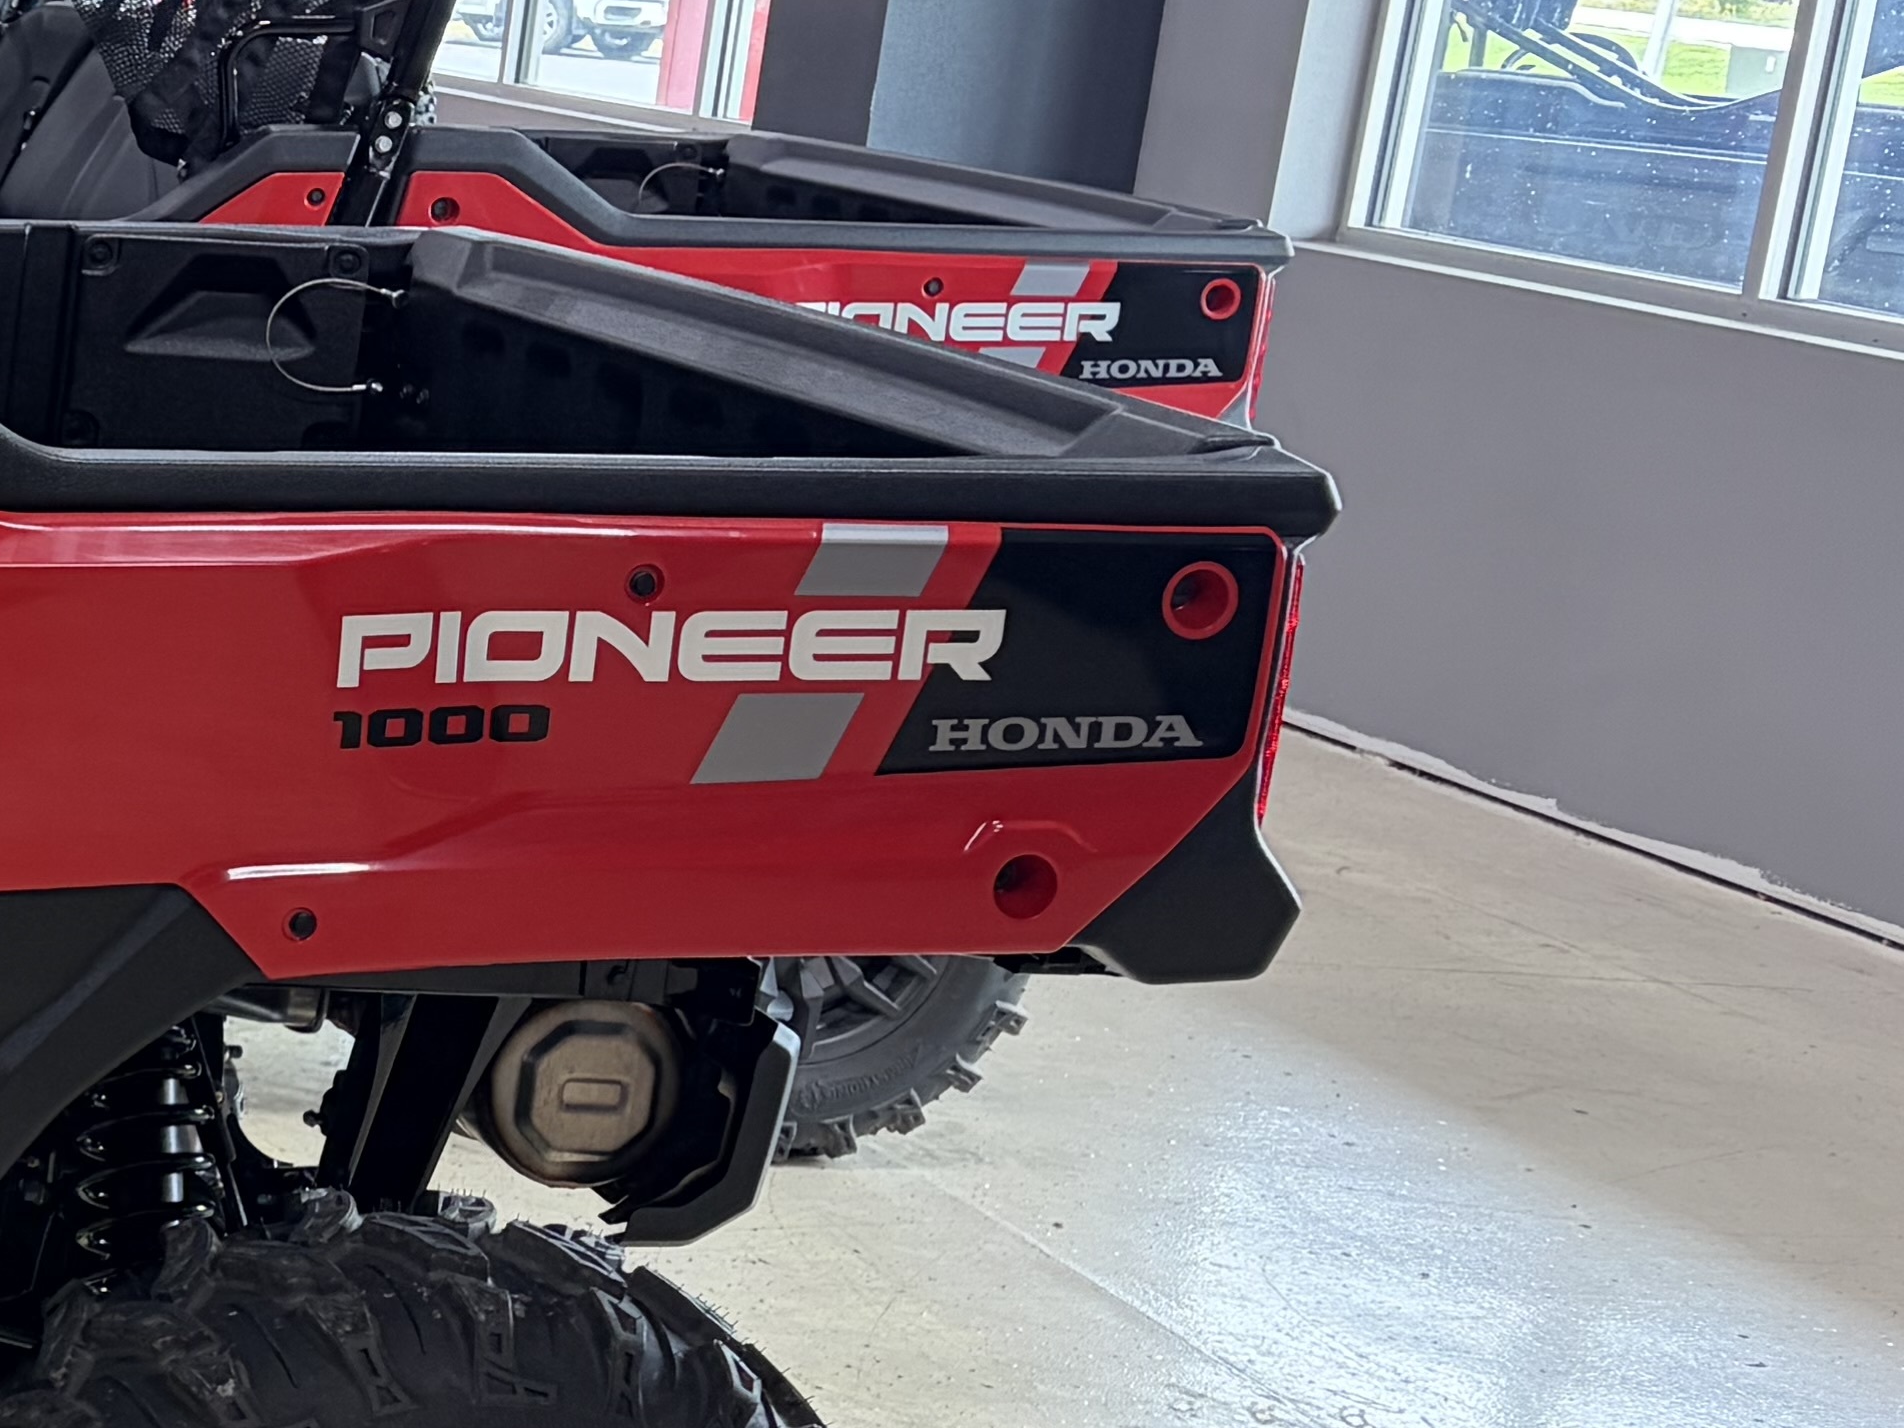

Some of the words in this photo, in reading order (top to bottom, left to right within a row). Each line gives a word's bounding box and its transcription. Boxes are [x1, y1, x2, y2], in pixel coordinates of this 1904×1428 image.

[795, 301, 1122, 342] ONEER
[1078, 359, 1223, 380] HONDA
[337, 609, 1007, 689] PIONEER
[333, 703, 551, 751] 1000
[928, 715, 1203, 752] HONDA
